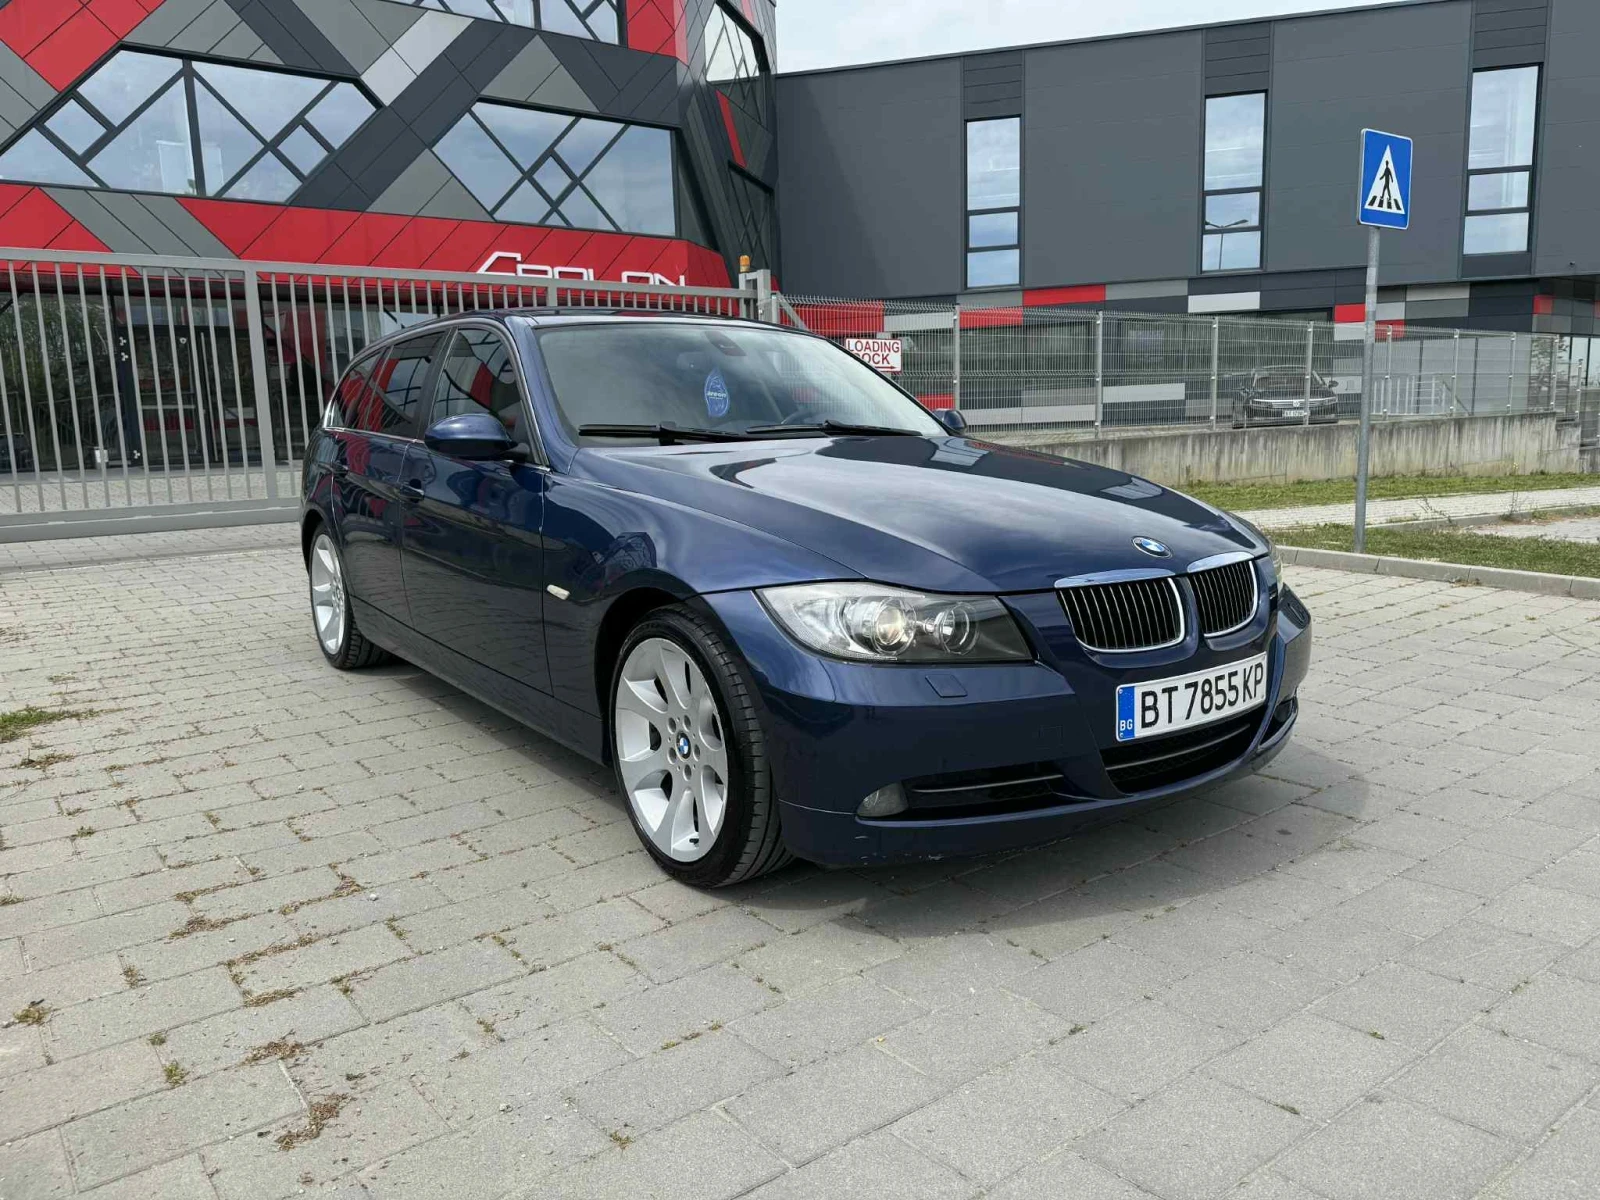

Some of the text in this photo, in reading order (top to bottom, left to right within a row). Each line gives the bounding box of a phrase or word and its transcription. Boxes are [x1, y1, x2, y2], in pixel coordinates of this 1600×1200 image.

[847, 340, 900, 353] LOADING
[1141, 662, 1264, 729] BT 7855 KP
[1119, 718, 1133, 731] BG
